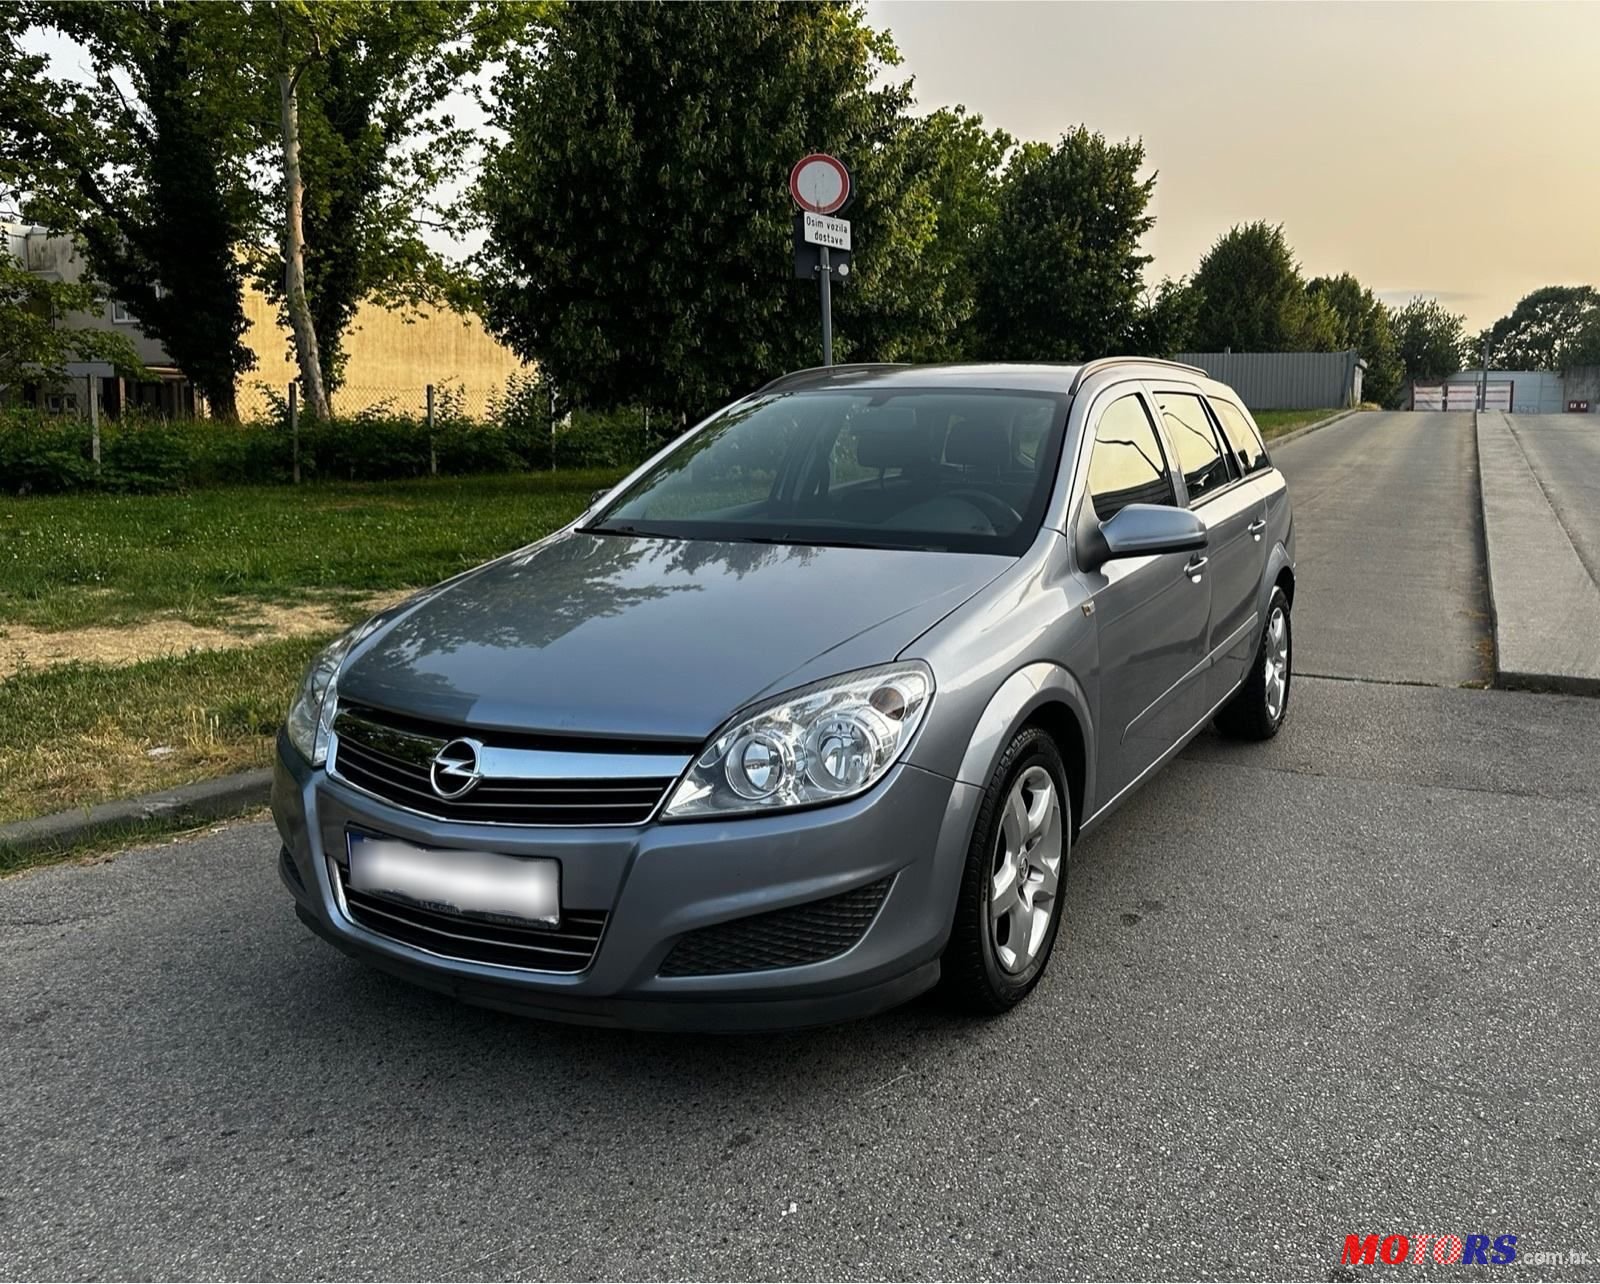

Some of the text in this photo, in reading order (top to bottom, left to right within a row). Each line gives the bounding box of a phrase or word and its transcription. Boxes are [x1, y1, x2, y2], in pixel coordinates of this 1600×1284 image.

[806, 215, 847, 234] Osim vozila
[814, 230, 843, 245] dostave
